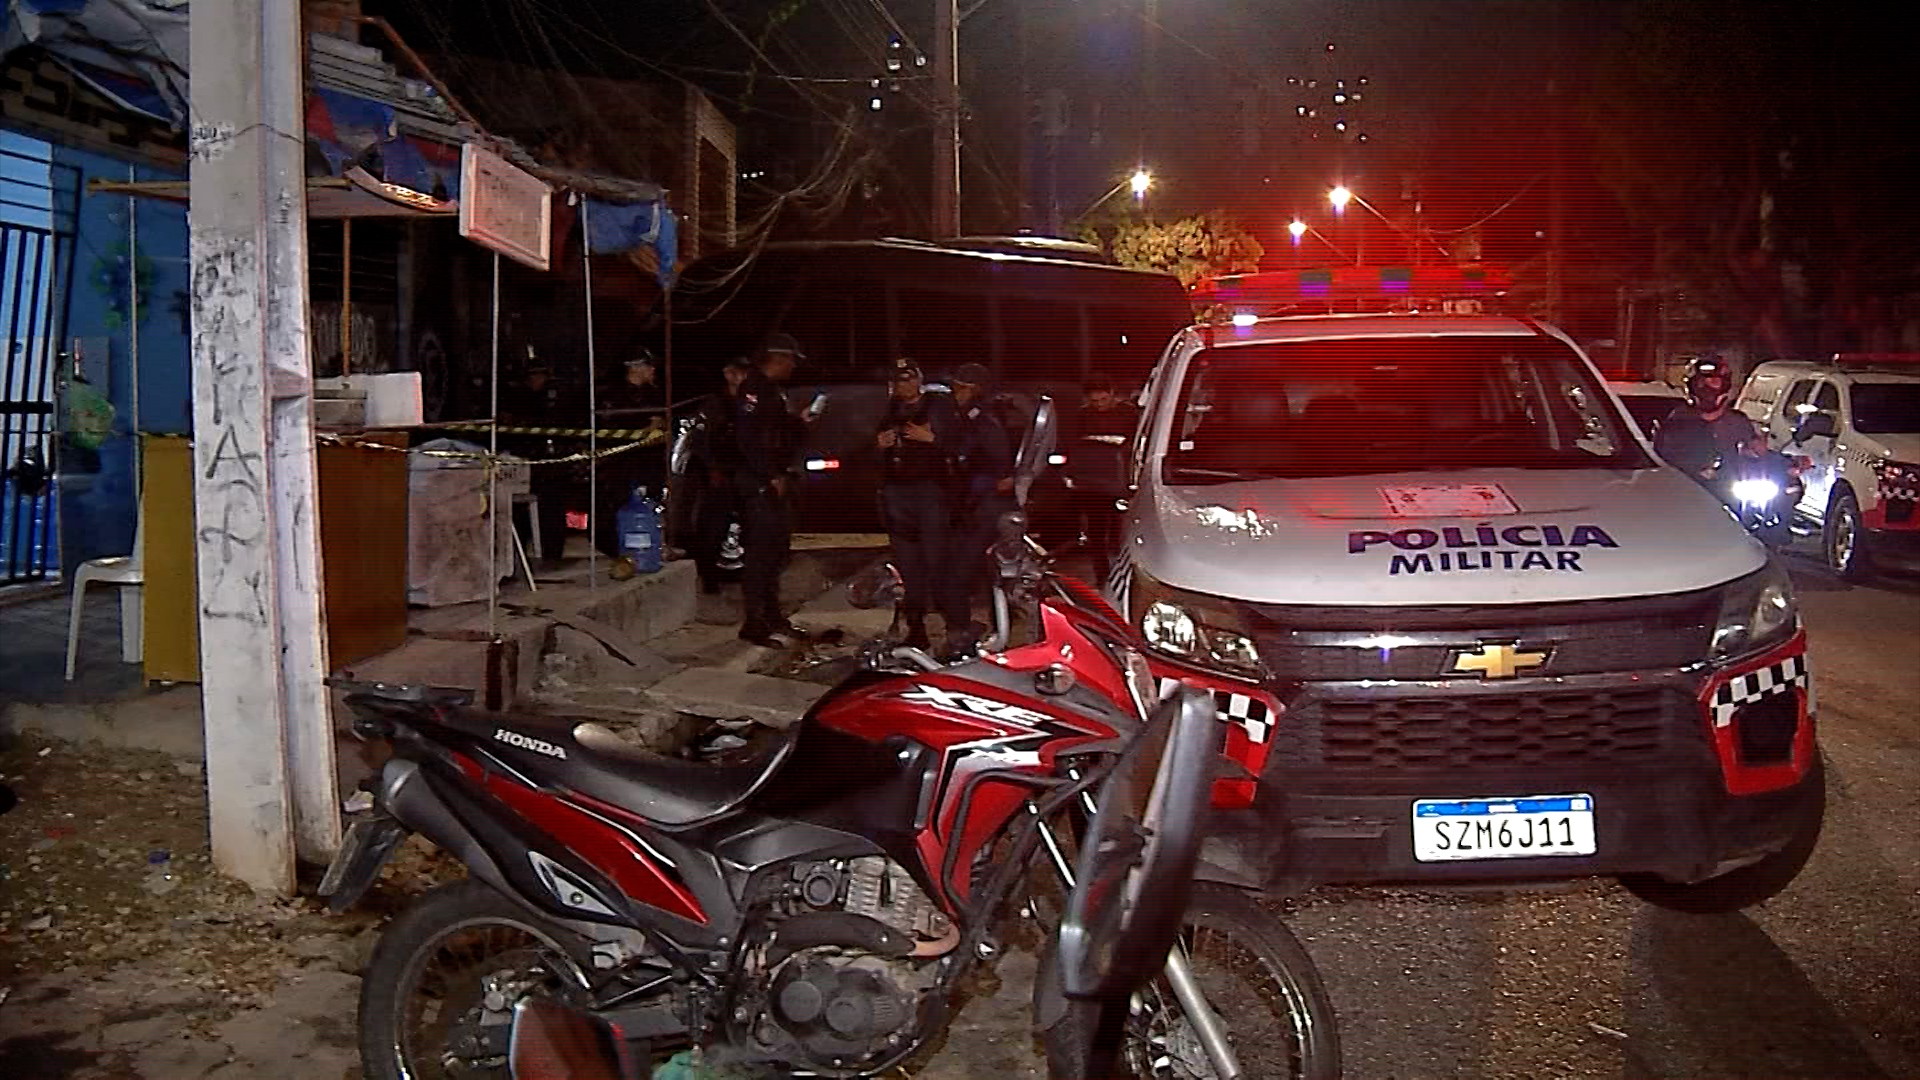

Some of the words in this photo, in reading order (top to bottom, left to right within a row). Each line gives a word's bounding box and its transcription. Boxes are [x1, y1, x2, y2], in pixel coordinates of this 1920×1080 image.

[1348, 522, 1621, 553] POLÍCIA
[1389, 551, 1584, 576] MILITAR
[900, 684, 1056, 726] XRE
[493, 729, 567, 760] HONDA
[1435, 817, 1574, 850] SZM6J11
